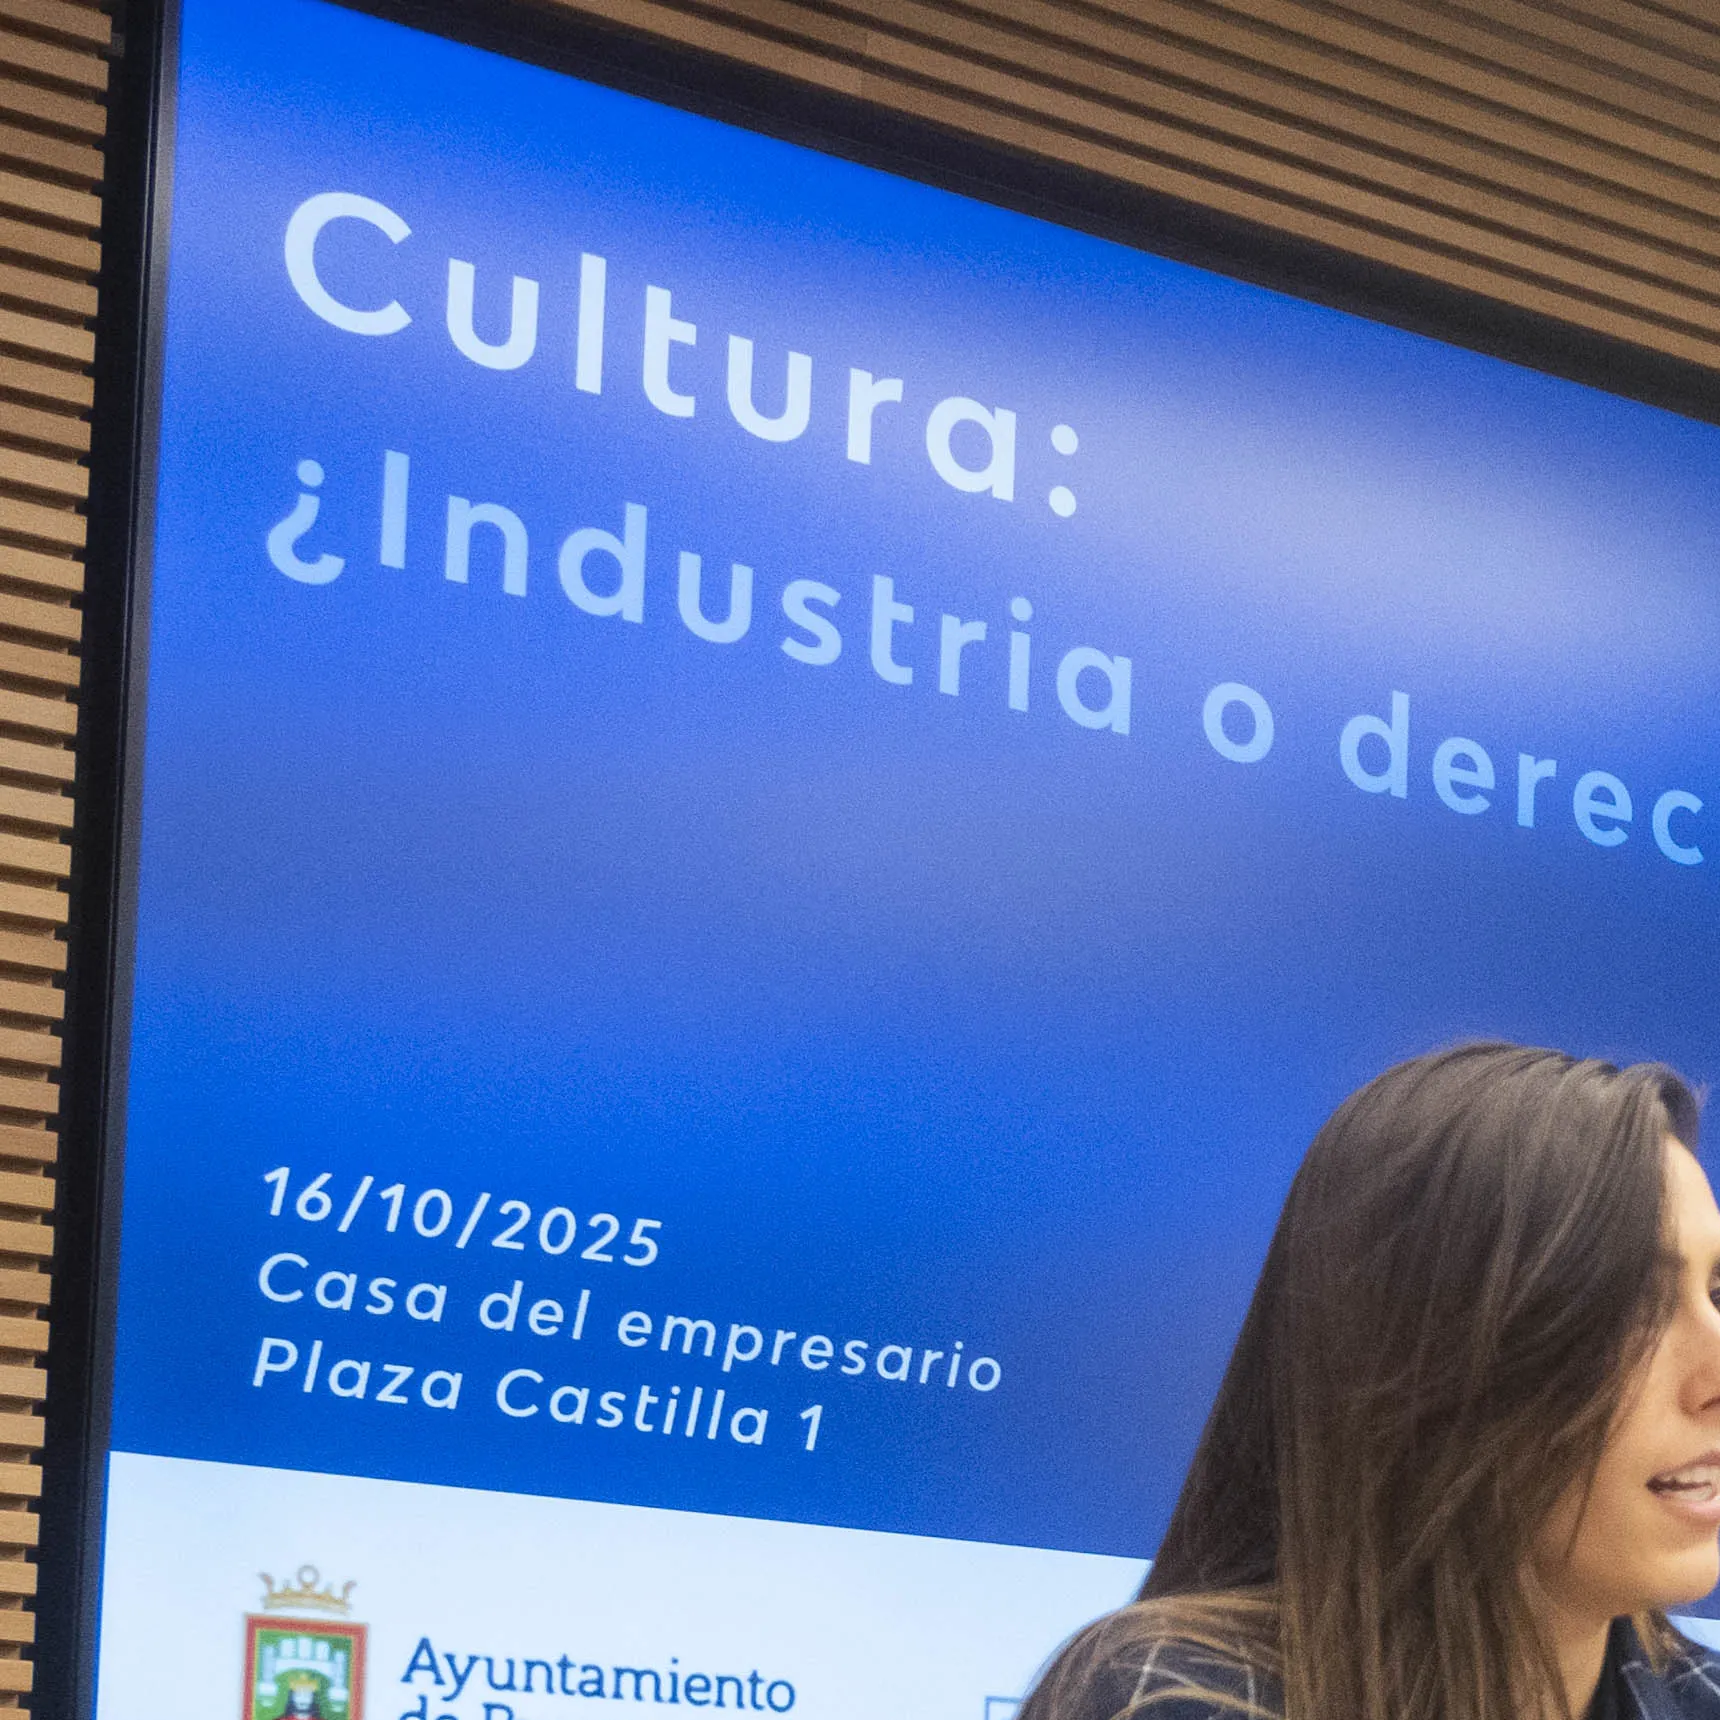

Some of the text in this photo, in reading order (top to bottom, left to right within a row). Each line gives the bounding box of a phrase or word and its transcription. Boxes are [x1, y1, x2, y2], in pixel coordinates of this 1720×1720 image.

[283, 191, 1080, 520] Cultura:
[266, 450, 1135, 738] ¿Industria
[1200, 681, 1277, 765] o
[261, 1165, 664, 1268] 16/10/2025
[257, 1252, 1003, 1392] Casa del empresario
[252, 1336, 824, 1452] Plaza Castilla 1
[399, 1636, 797, 1715] Ayuntamiento
